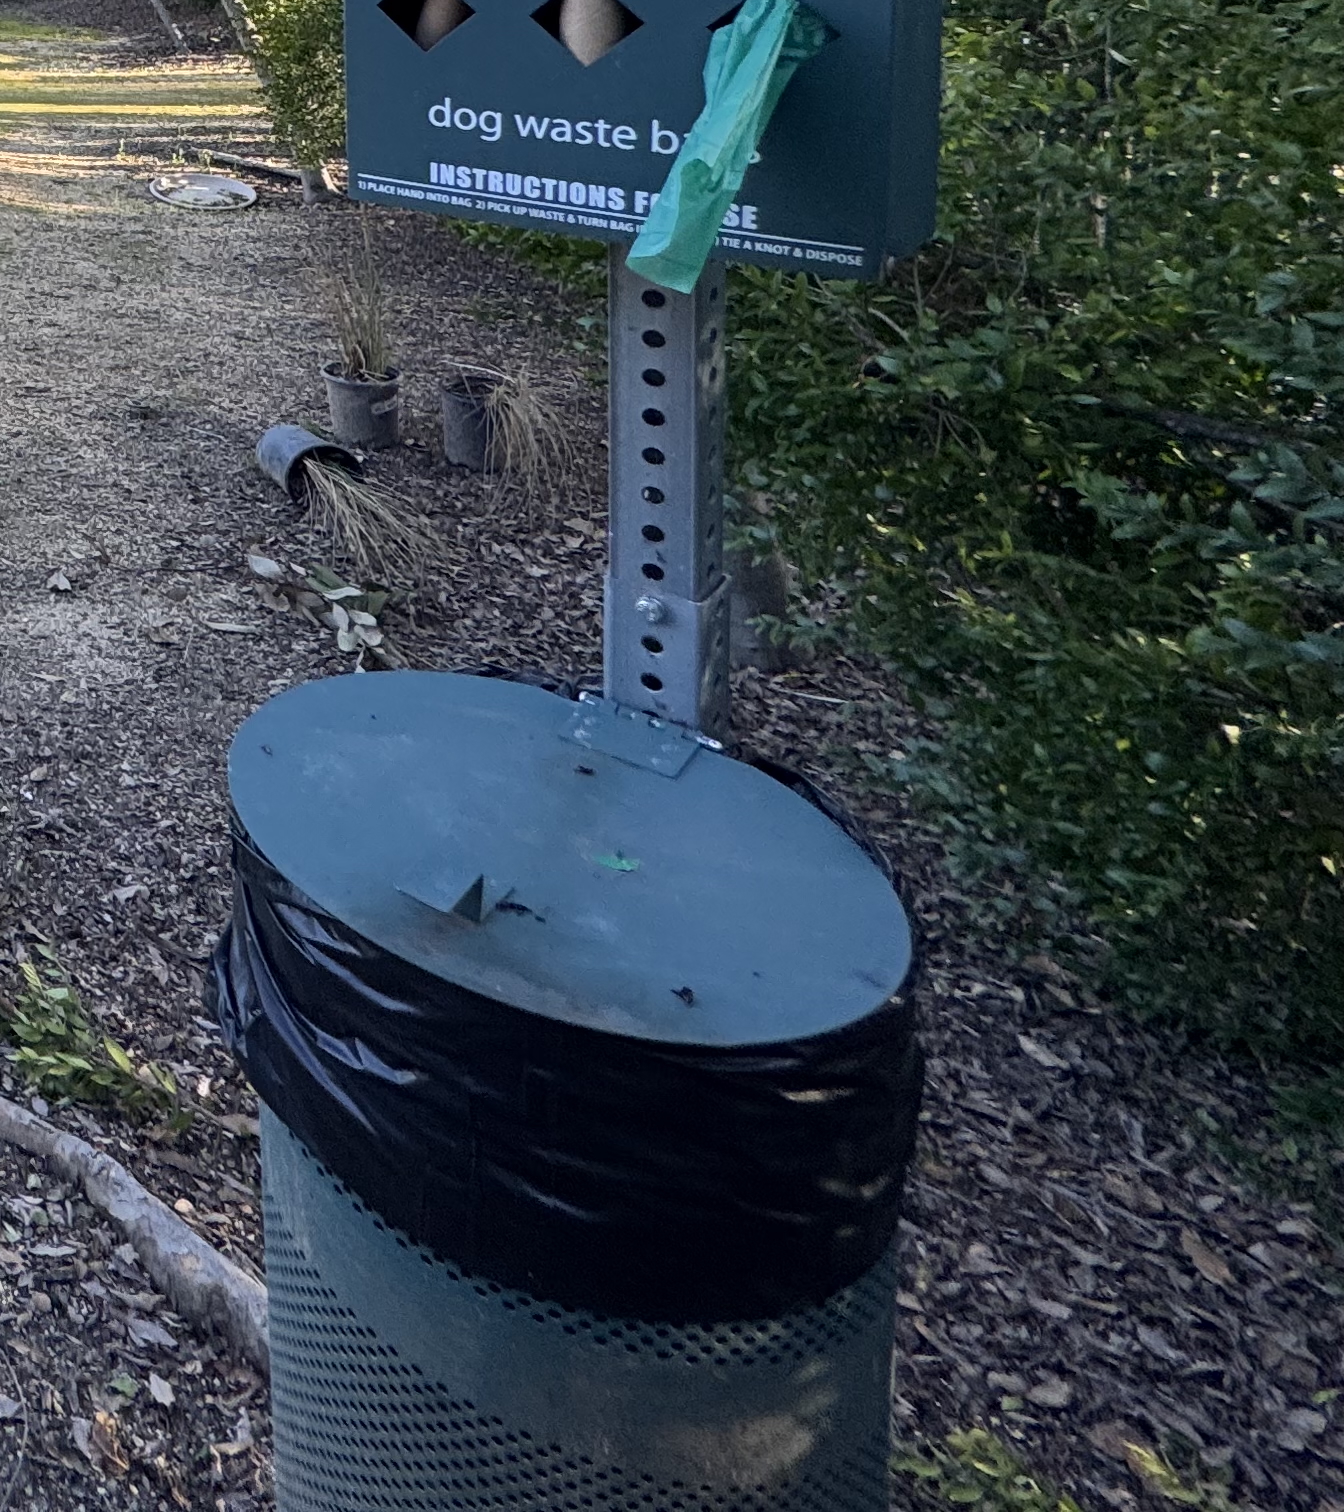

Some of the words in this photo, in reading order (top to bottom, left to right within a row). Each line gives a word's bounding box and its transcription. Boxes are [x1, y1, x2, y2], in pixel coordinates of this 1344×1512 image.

[427, 97, 503, 144] dog
[513, 112, 638, 151] waste
[357, 180, 366, 191] 1)
[367, 182, 396, 195] PLACE
[396, 186, 425, 200] HAND
[425, 191, 450, 204] INTO
[450, 195, 473, 208] BAG
[475, 200, 486, 211] 2)
[487, 202, 511, 215] PICK
[512, 205, 528, 217] UP
[528, 207, 565, 223] WASTE
[566, 213, 576, 224] &
[577, 215, 609, 229] TURN
[609, 220, 634, 233] BAG
[721, 236, 741, 249] TIE
[742, 240, 753, 251] A
[754, 241, 790, 256] KNOT
[792, 247, 804, 258] &
[805, 249, 863, 267] DISPOSE
[429, 161, 626, 211] INSTRUCTIONS
[721, 202, 759, 230] SE
